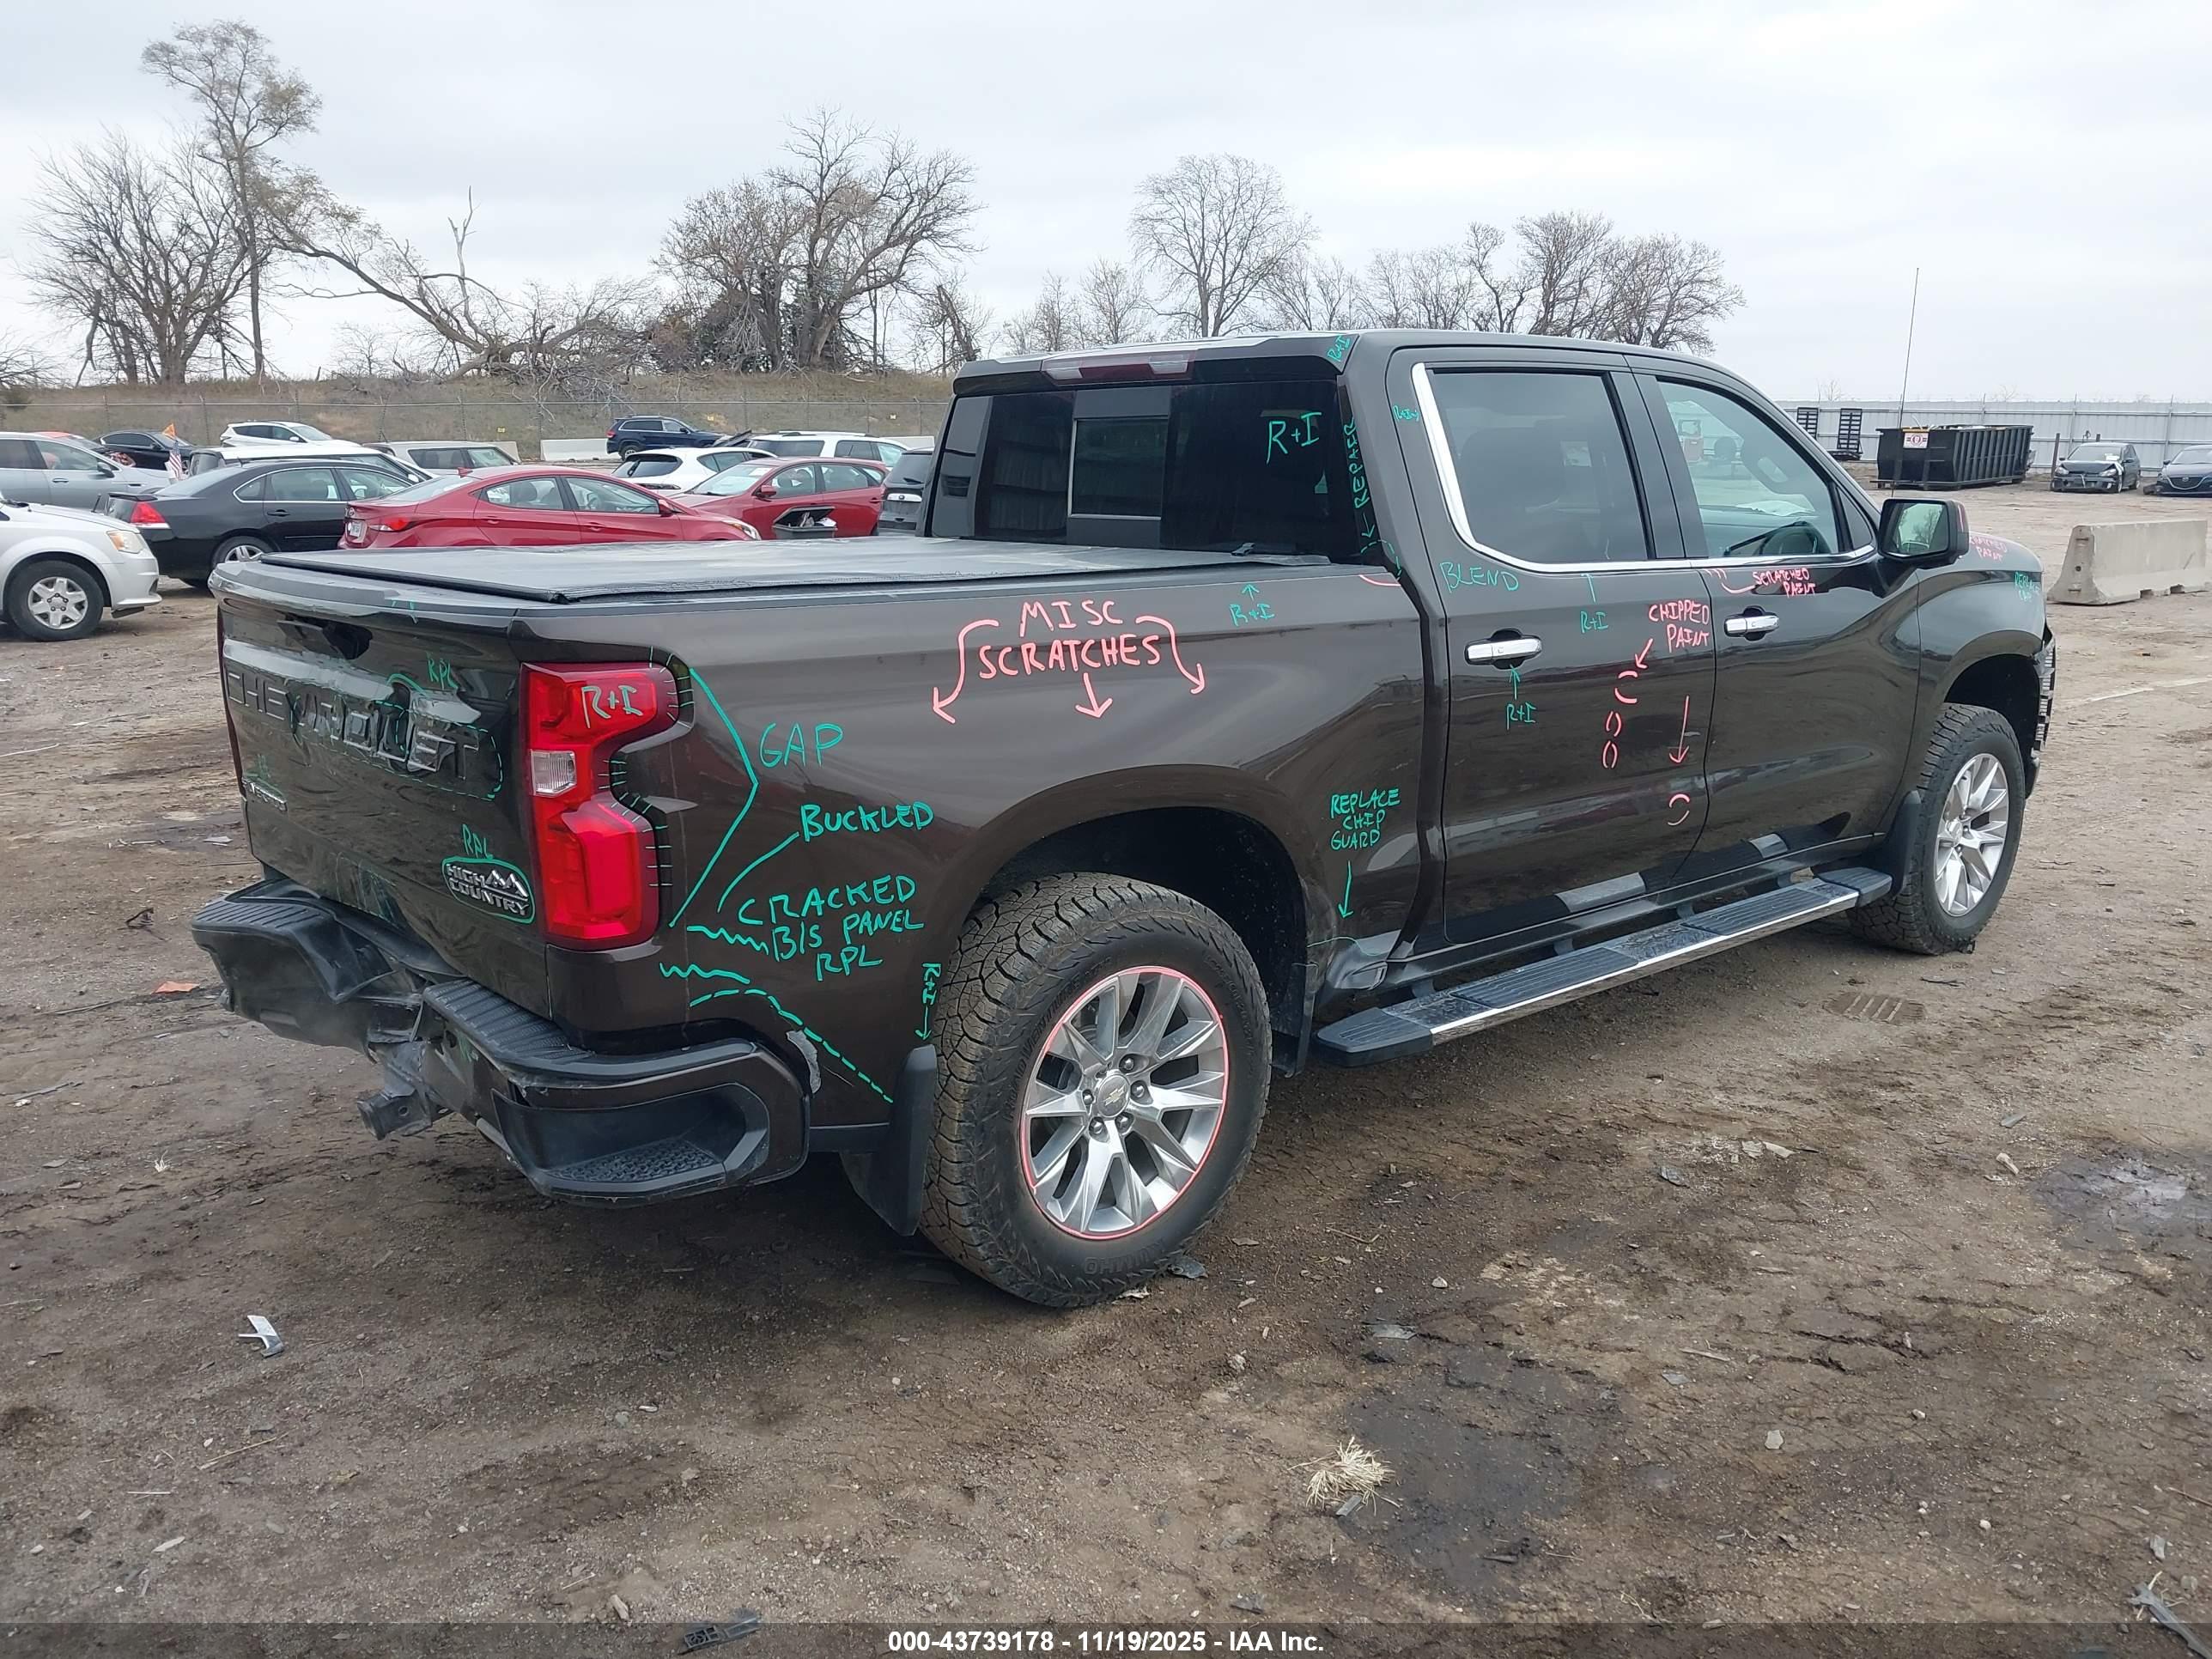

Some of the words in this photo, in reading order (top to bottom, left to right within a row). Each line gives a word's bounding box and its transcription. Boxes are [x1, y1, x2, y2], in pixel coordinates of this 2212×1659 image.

[1266, 412, 1322, 465] R+I
[1439, 561, 1519, 593] BLEND
[1019, 600, 1123, 637] MISC
[1648, 599, 1711, 625] CHIPPED
[1666, 623, 1711, 653] PAINT
[979, 634, 1161, 679] SCRATCHES
[580, 684, 643, 729] R+I
[1505, 702, 1537, 730] R+I
[759, 722, 843, 767] GAP
[799, 800, 934, 842] BUCKLED
[1330, 787, 1401, 819] REPLACE
[1342, 809, 1386, 830] CHIP
[1330, 829, 1381, 851] GUARD
[446, 862, 487, 888] HIGH
[448, 877, 530, 916] COUNTRY
[738, 874, 916, 926] CRACKED
[842, 908, 925, 945] PANEL
[816, 945, 884, 981] RPL
